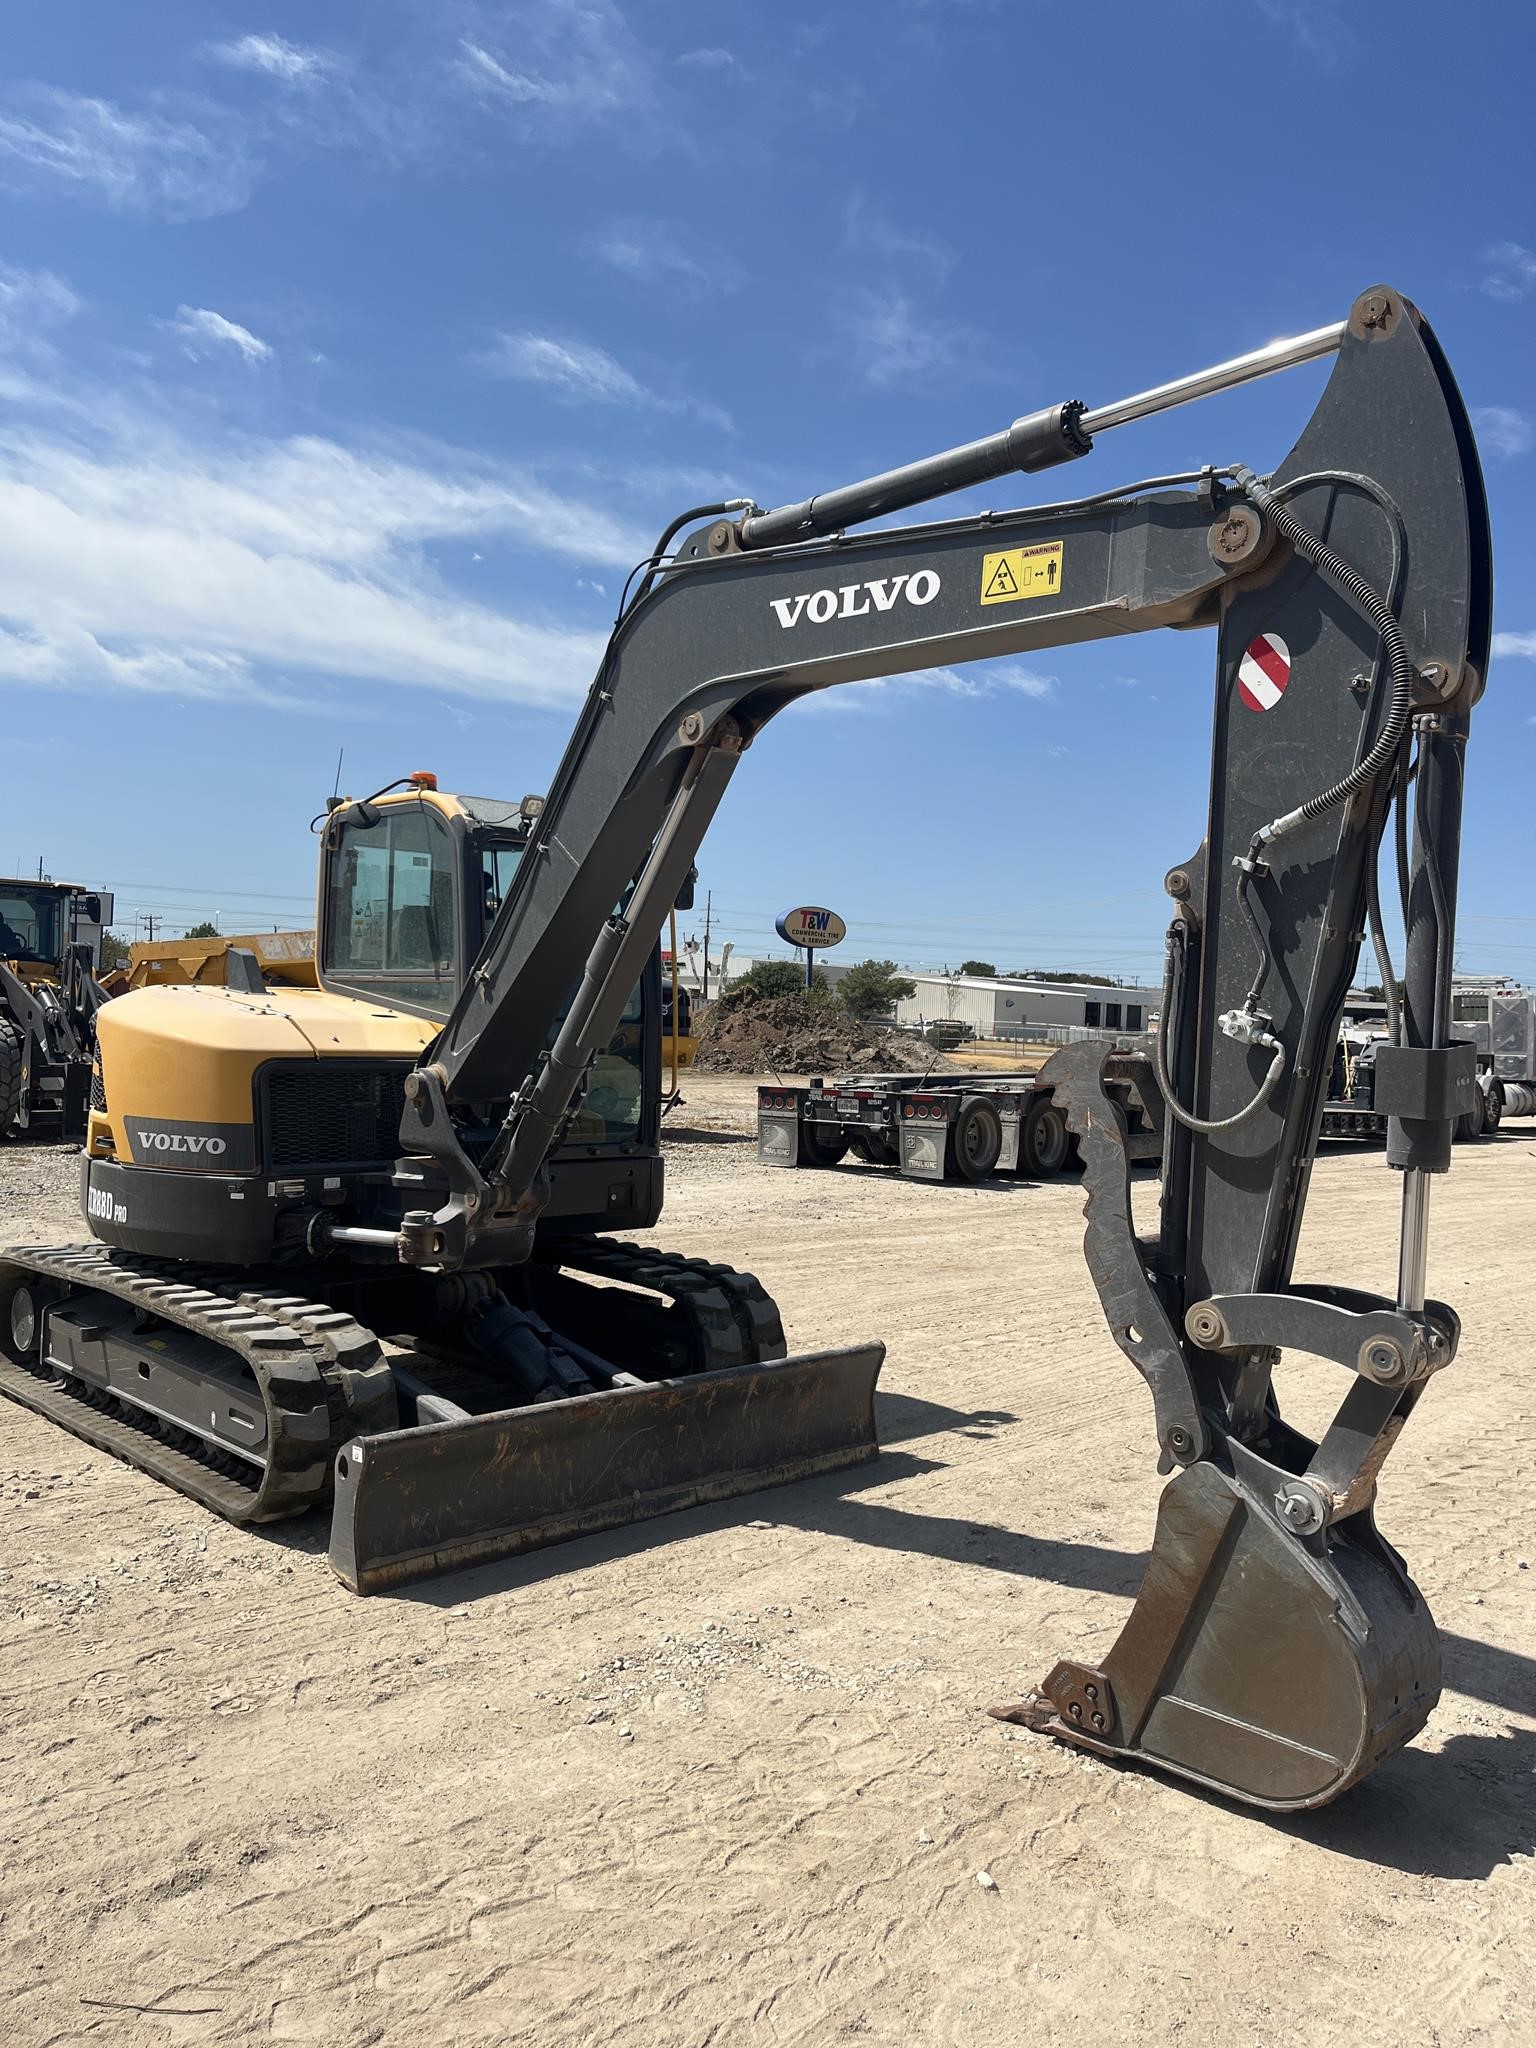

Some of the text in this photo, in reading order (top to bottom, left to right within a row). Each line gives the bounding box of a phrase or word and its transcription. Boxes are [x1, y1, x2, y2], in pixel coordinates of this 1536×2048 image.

[1029, 544, 1060, 556] WARNING
[769, 569, 941, 629] VOLVO
[801, 910, 831, 931] T&W
[791, 929, 826, 938] COMMERCIAL
[137, 1132, 227, 1155] VOLVO
[114, 1204, 127, 1223] PRO
